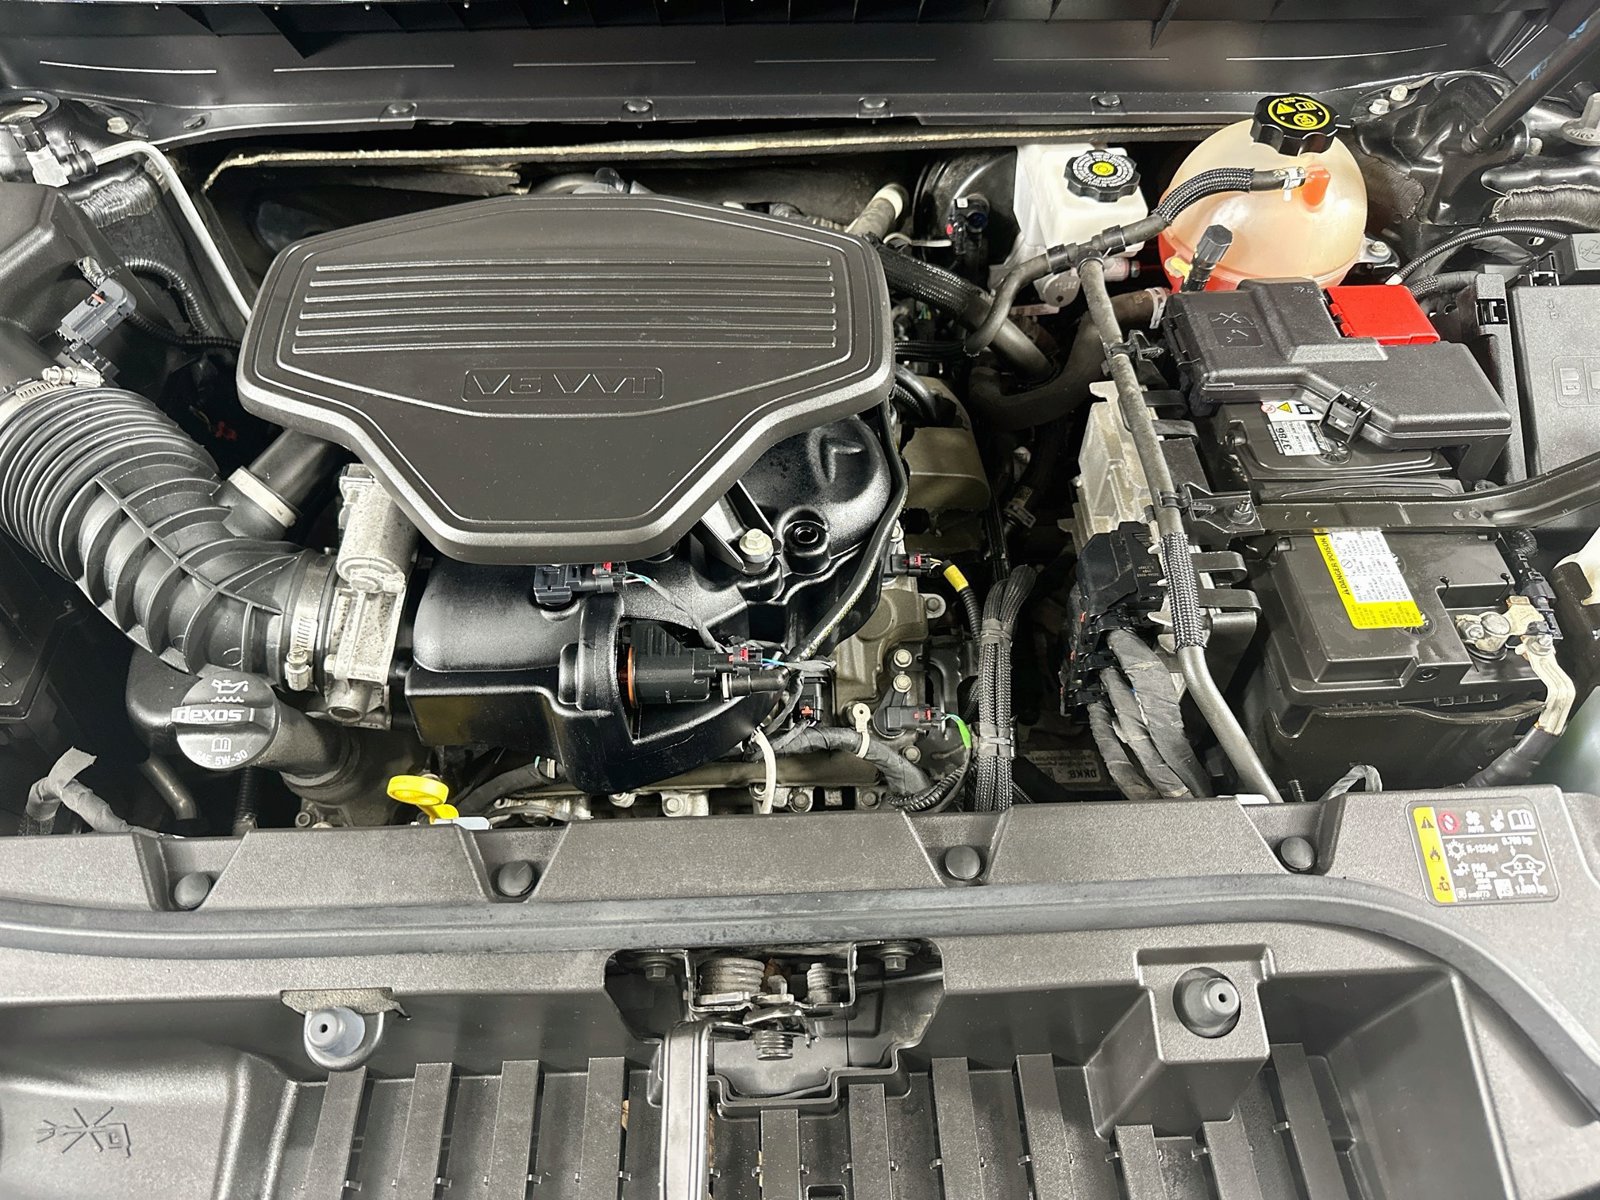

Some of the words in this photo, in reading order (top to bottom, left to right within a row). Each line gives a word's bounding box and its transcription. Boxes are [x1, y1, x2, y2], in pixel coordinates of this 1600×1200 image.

[473, 373, 542, 395] V6
[553, 373, 656, 394] VVT
[1275, 427, 1292, 450] 3786
[1320, 537, 1336, 562] POISON
[1331, 562, 1348, 592] DANGER
[177, 706, 245, 722] dexos
[214, 749, 248, 766] 5W-30
